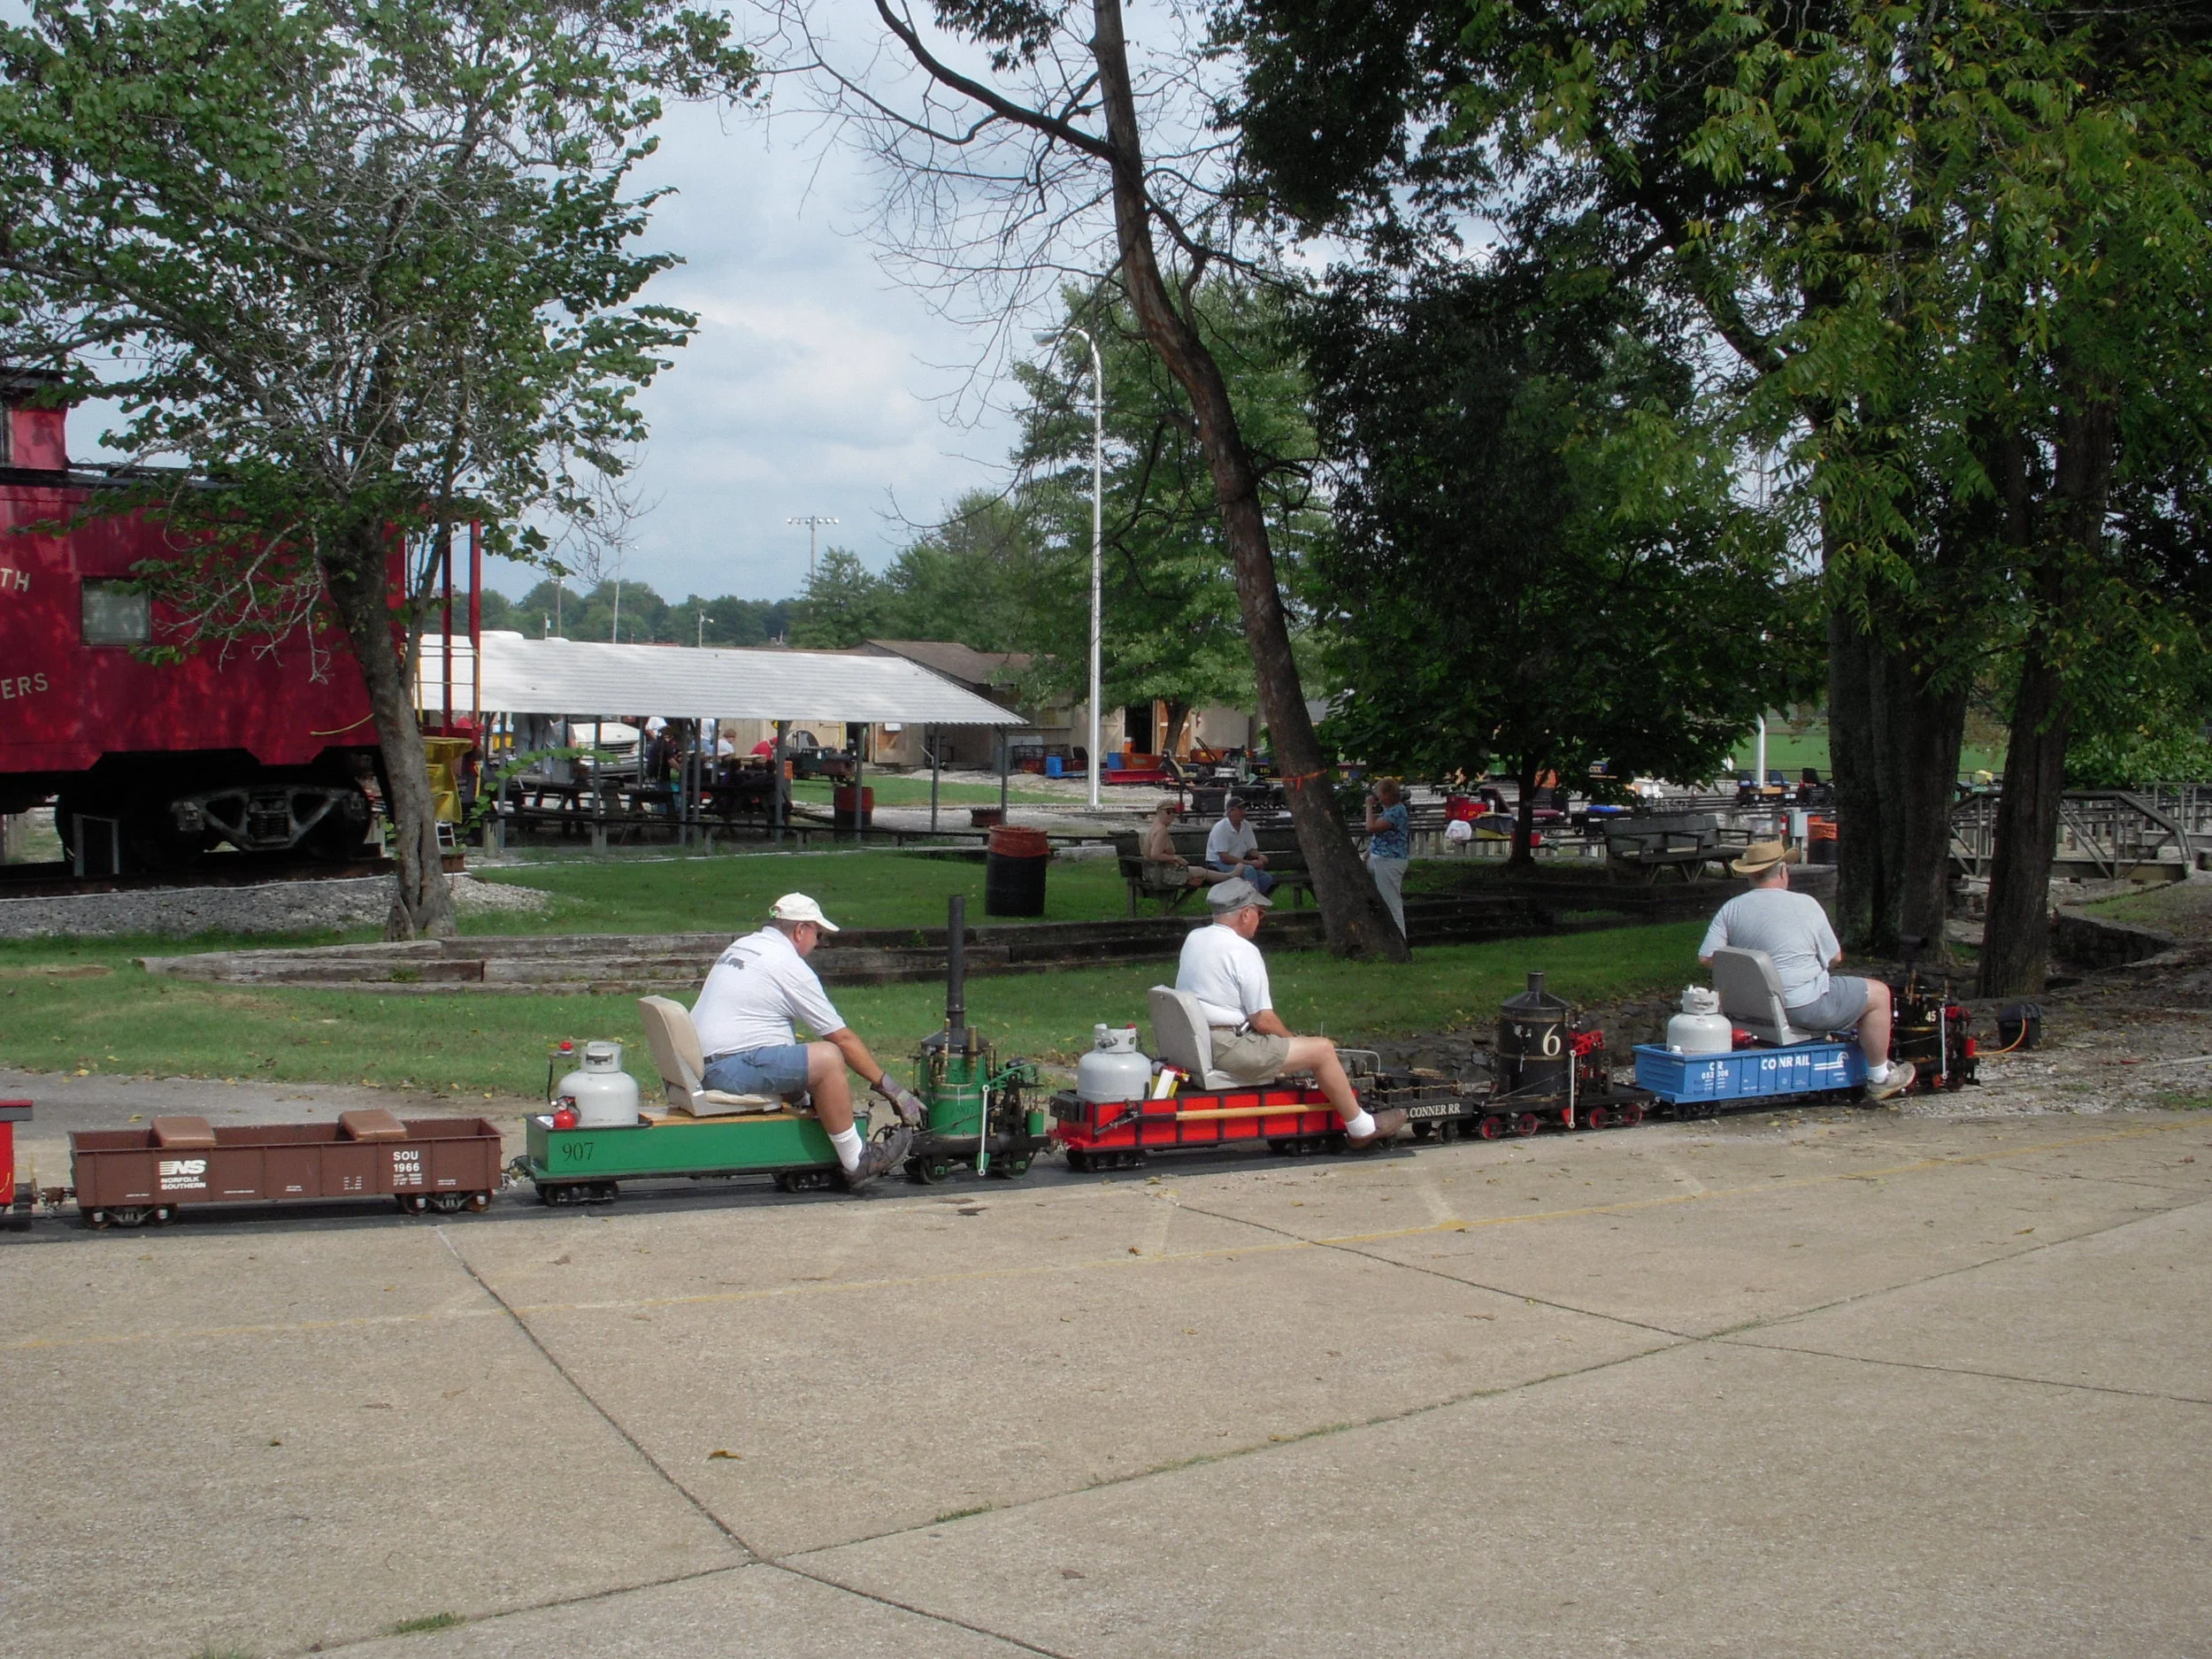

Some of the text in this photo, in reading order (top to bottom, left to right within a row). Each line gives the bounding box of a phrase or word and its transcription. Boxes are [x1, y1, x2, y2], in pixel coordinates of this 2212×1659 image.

[1924, 1010, 1937, 1022] 45
[1542, 1024, 1561, 1056] 6
[1409, 1104, 1447, 1118] CONNER
[1448, 1102, 1461, 1115] RR
[393, 1150, 419, 1161] SOU
[563, 1142, 594, 1161] 907
[159, 1159, 207, 1175] NS
[393, 1163, 420, 1172] 1966
